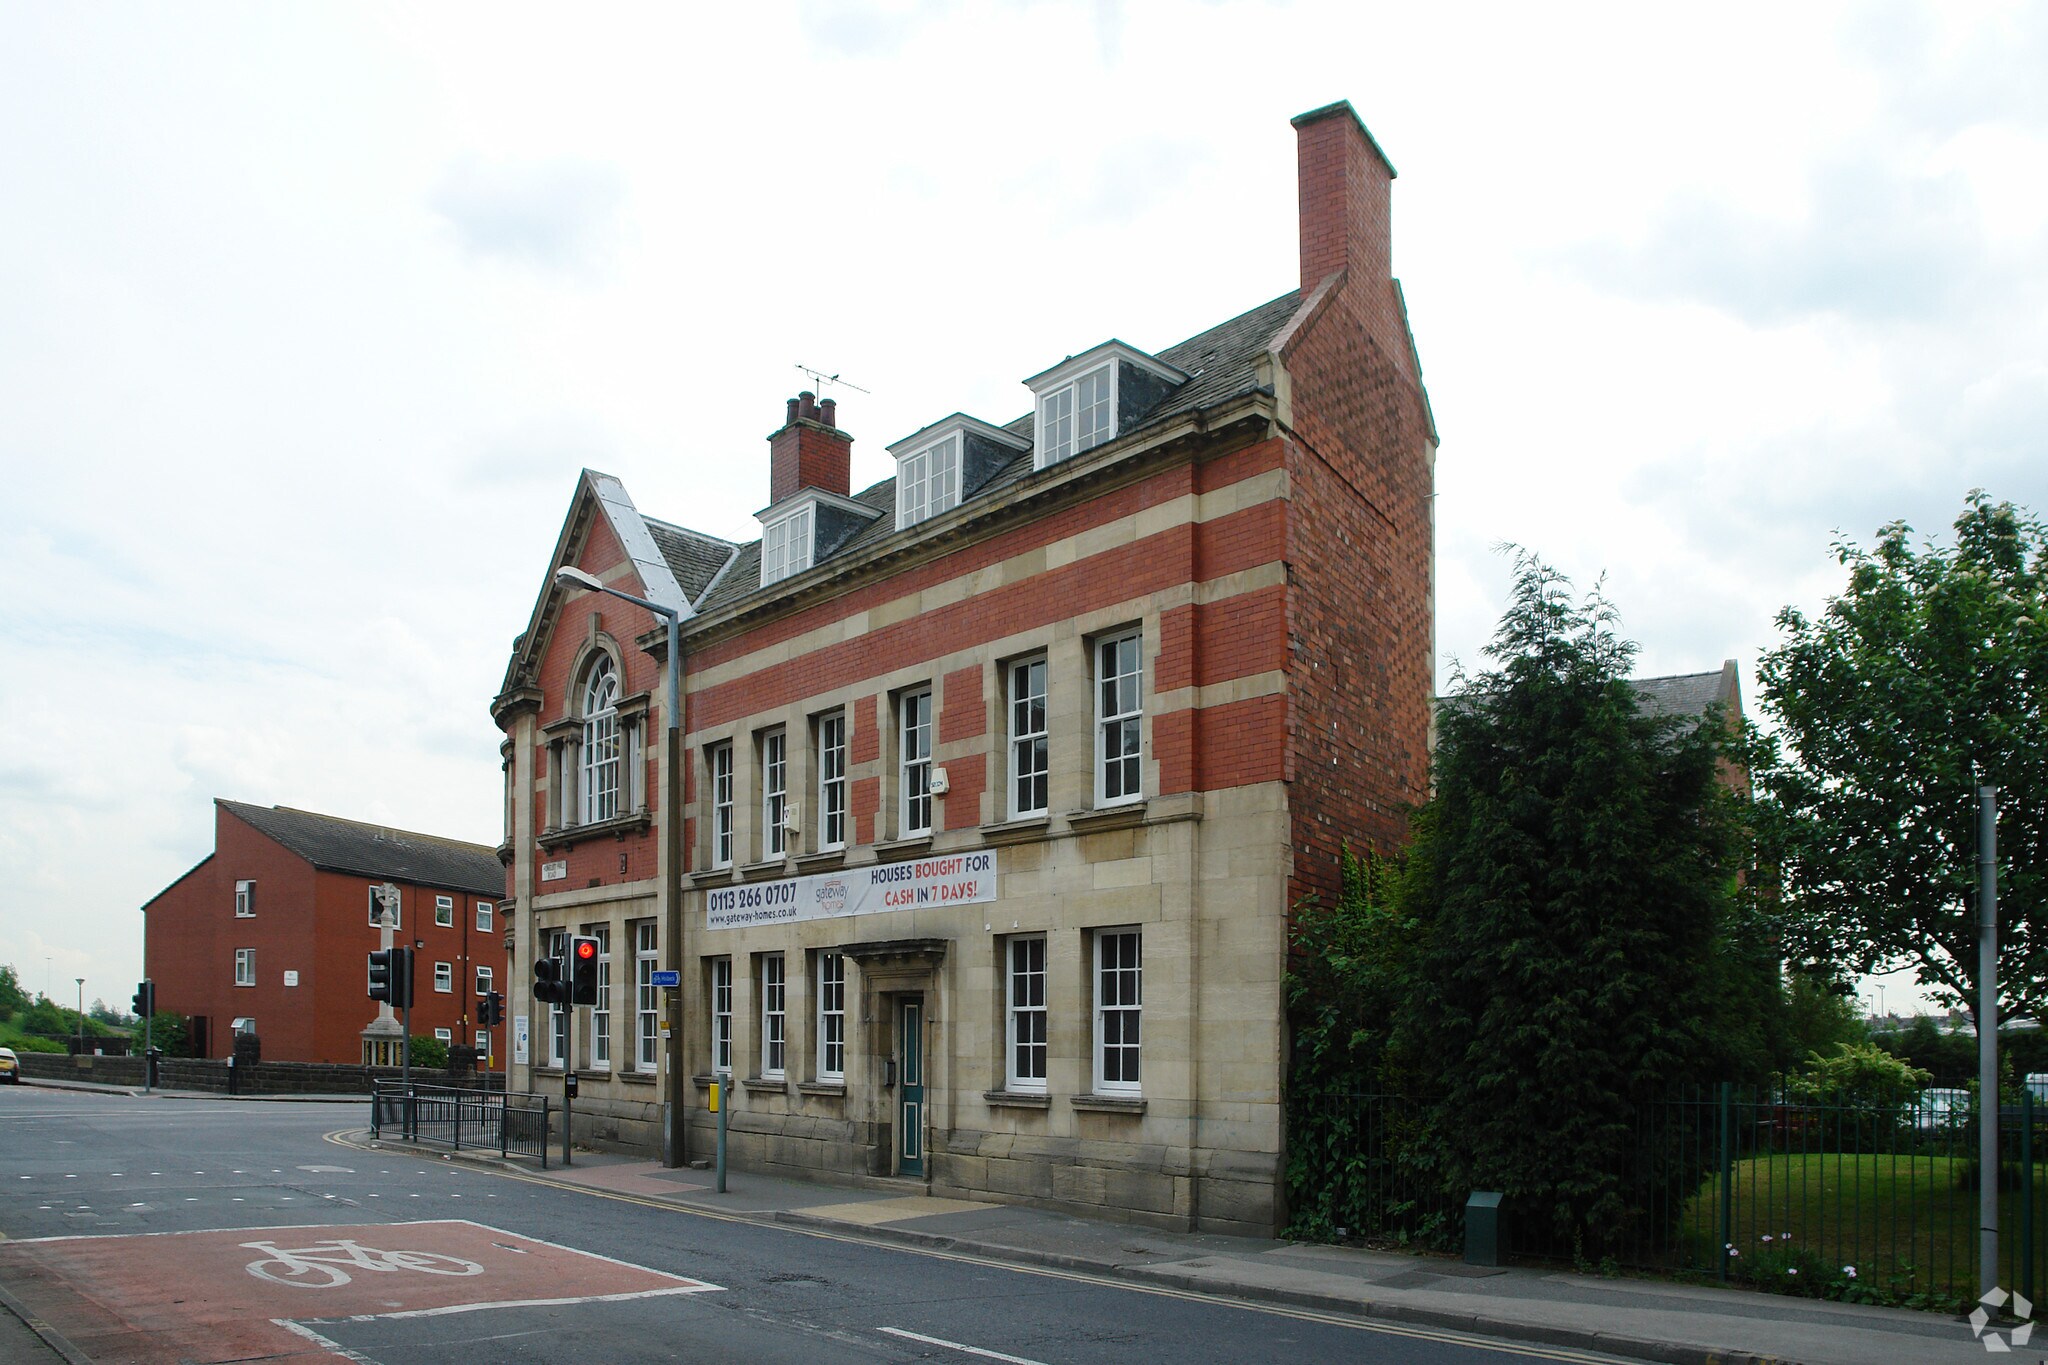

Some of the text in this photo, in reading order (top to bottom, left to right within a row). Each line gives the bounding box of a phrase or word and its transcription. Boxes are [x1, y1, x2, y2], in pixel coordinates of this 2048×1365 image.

[871, 855, 990, 885] HOUSES BOUGHT FOR
[711, 882, 797, 911] 0113 266 0707
[815, 885, 850, 903] gateway
[885, 880, 977, 906] CASH IN 7 DAYS!
[710, 906, 797, 925] www.gateway-homes.co.uk
[821, 899, 844, 911] homes
